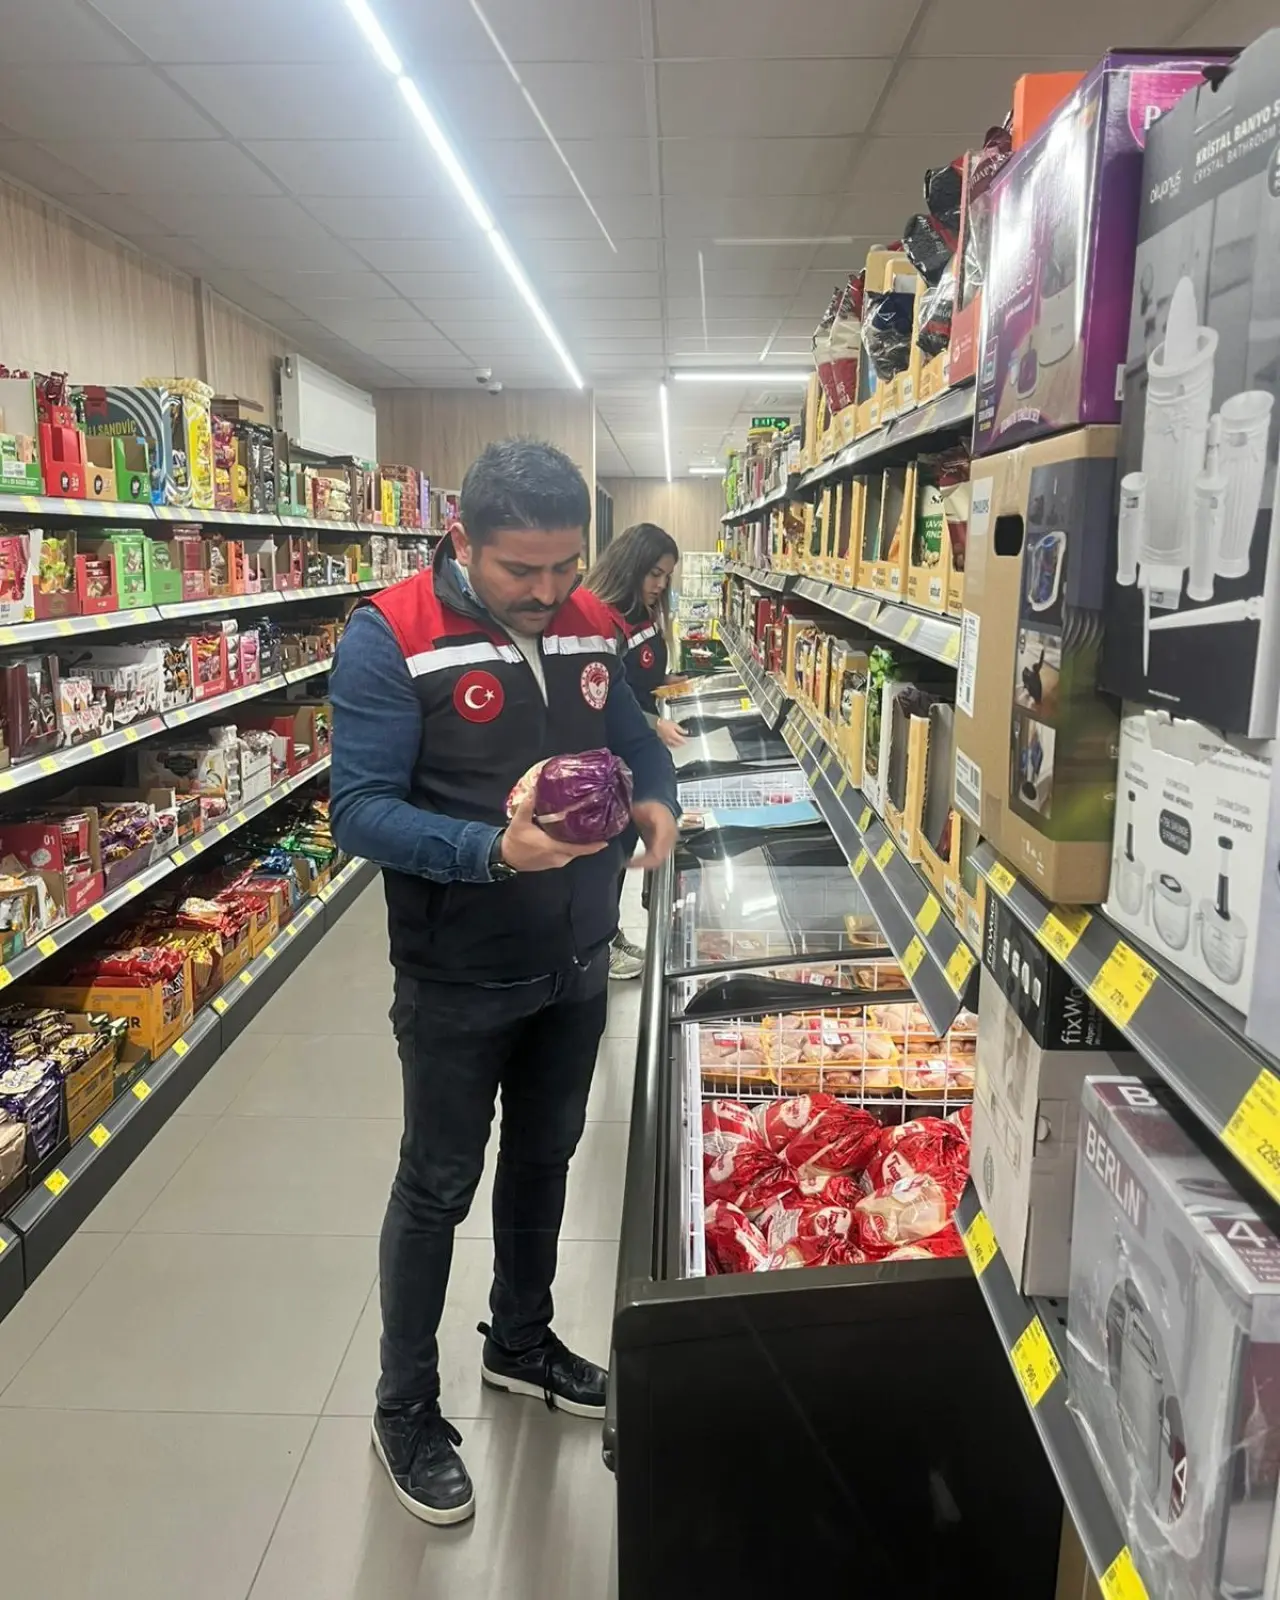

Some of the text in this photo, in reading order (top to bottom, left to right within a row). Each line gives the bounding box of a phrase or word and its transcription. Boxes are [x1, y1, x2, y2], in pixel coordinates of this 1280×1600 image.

[1193, 124, 1276, 185] CRYSTAL BATHROOM
[1195, 131, 1232, 167] KRİSTAL
[1233, 106, 1271, 142] BANYO
[1226, 1220, 1268, 1248] 4
